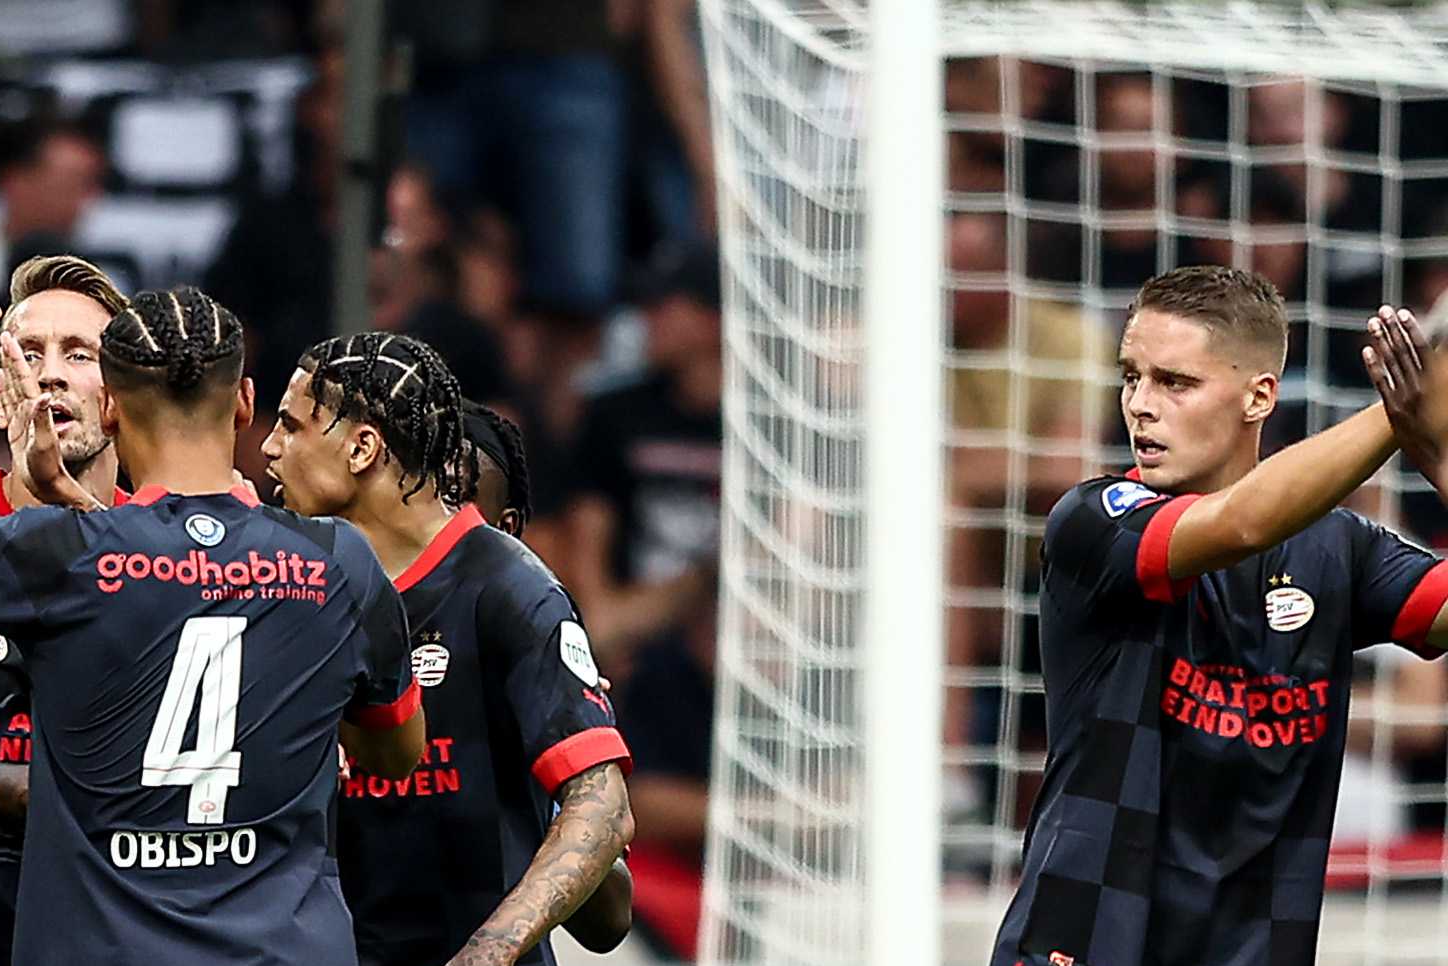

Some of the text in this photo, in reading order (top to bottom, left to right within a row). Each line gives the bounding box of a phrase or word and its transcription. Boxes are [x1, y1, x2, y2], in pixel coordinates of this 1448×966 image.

[97, 550, 327, 593] goodhabitz
[260, 587, 327, 605] training
[141, 616, 248, 825] 4
[110, 829, 256, 869] OBISPO
